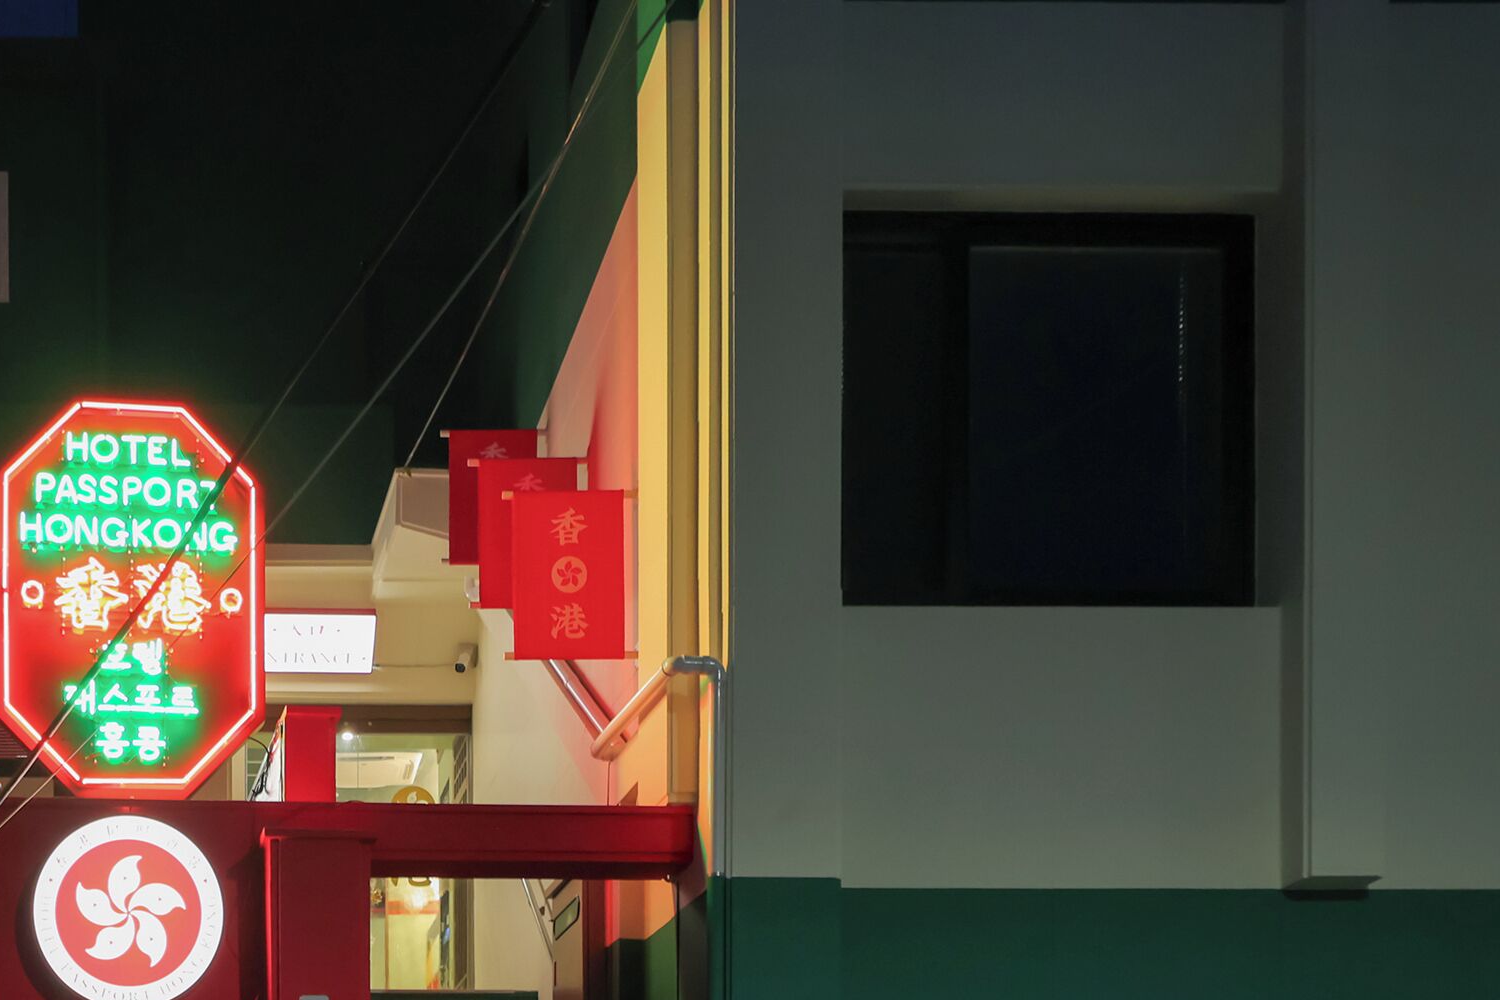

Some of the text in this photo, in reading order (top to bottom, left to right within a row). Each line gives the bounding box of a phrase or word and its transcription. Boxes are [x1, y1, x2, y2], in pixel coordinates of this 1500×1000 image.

[65, 431, 191, 468] HOTEL
[33, 472, 217, 511] PASSPORT
[18, 510, 238, 552] HONGKONG
[54, 556, 211, 634] 香港
[95, 724, 166, 762] 홍콩
